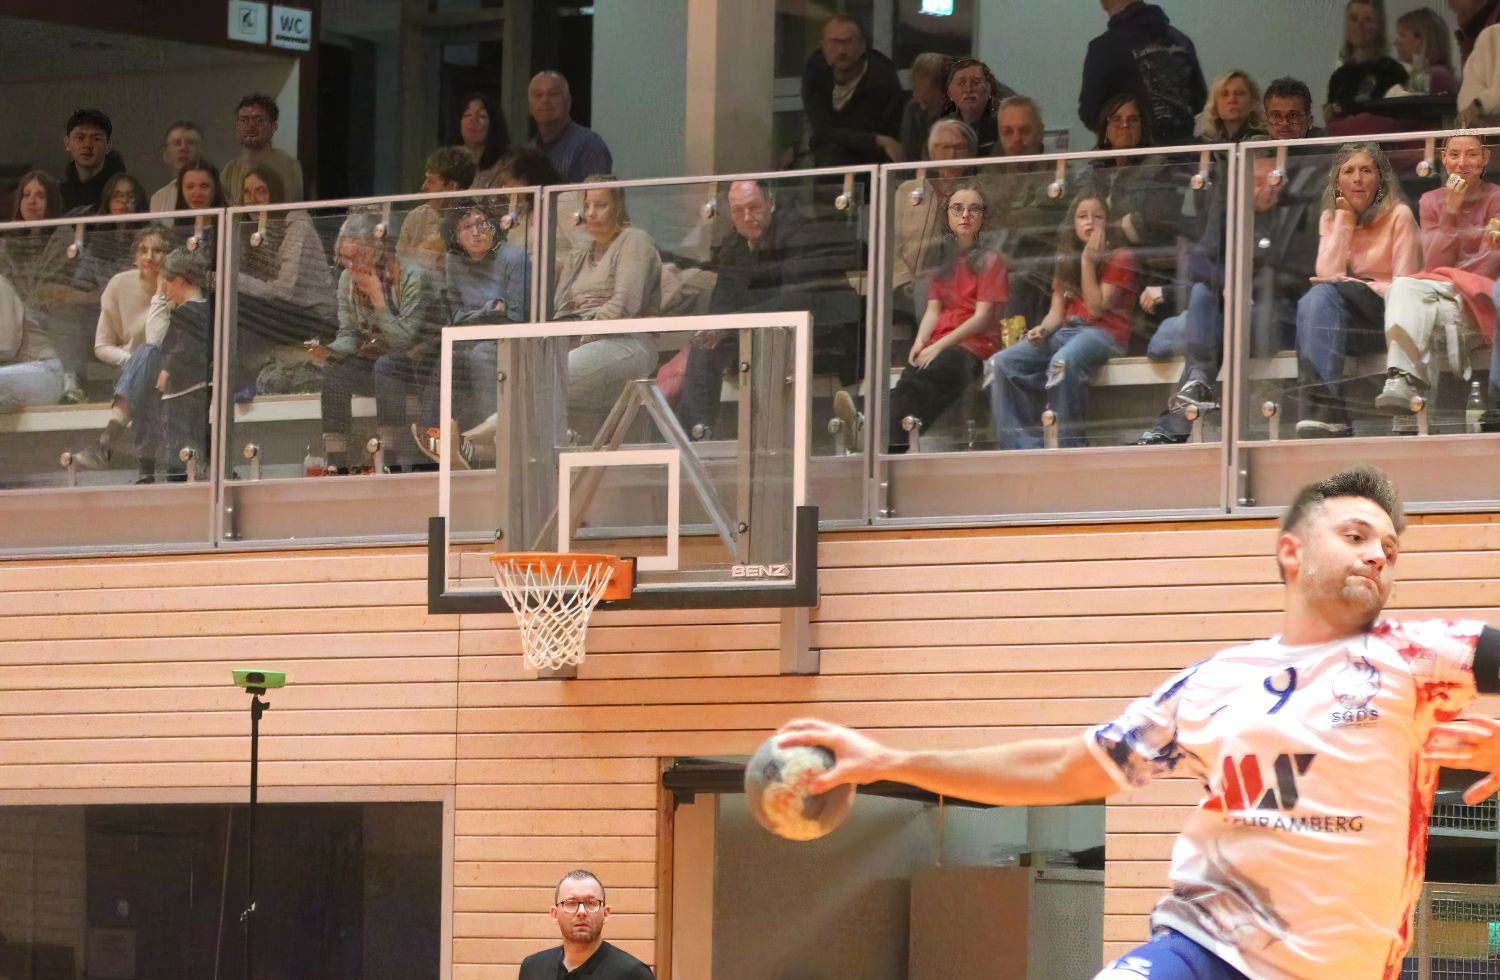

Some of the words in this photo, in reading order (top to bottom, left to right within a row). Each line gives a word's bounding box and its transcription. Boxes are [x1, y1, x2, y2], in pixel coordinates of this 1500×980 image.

[280, 15, 304, 34] WC
[732, 564, 788, 577] BENZ
[1264, 667, 1298, 714] 9
